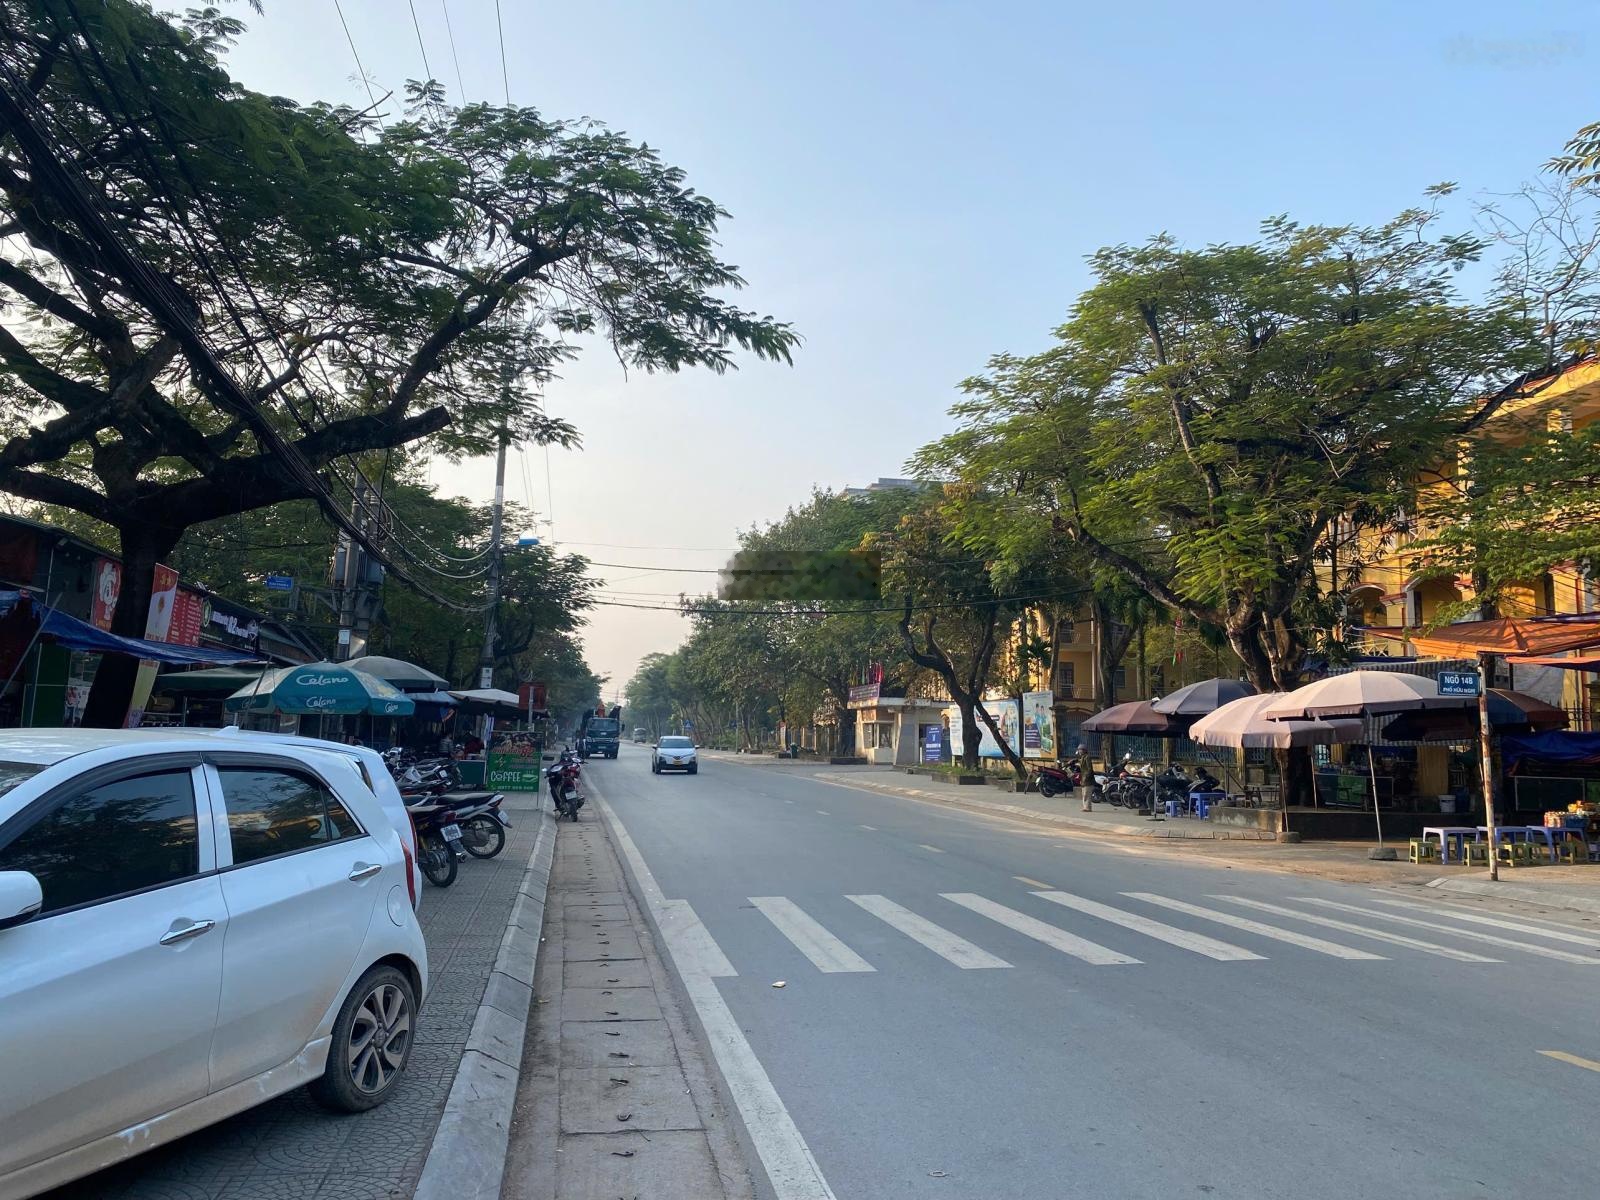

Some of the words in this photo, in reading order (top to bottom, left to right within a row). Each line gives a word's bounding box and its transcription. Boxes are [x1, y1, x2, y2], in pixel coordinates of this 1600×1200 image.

[296, 674, 349, 686] Celano
[1444, 674, 1460, 684] NGÕ
[306, 696, 337, 708] Celano
[490, 771, 520, 782] COFFEE
